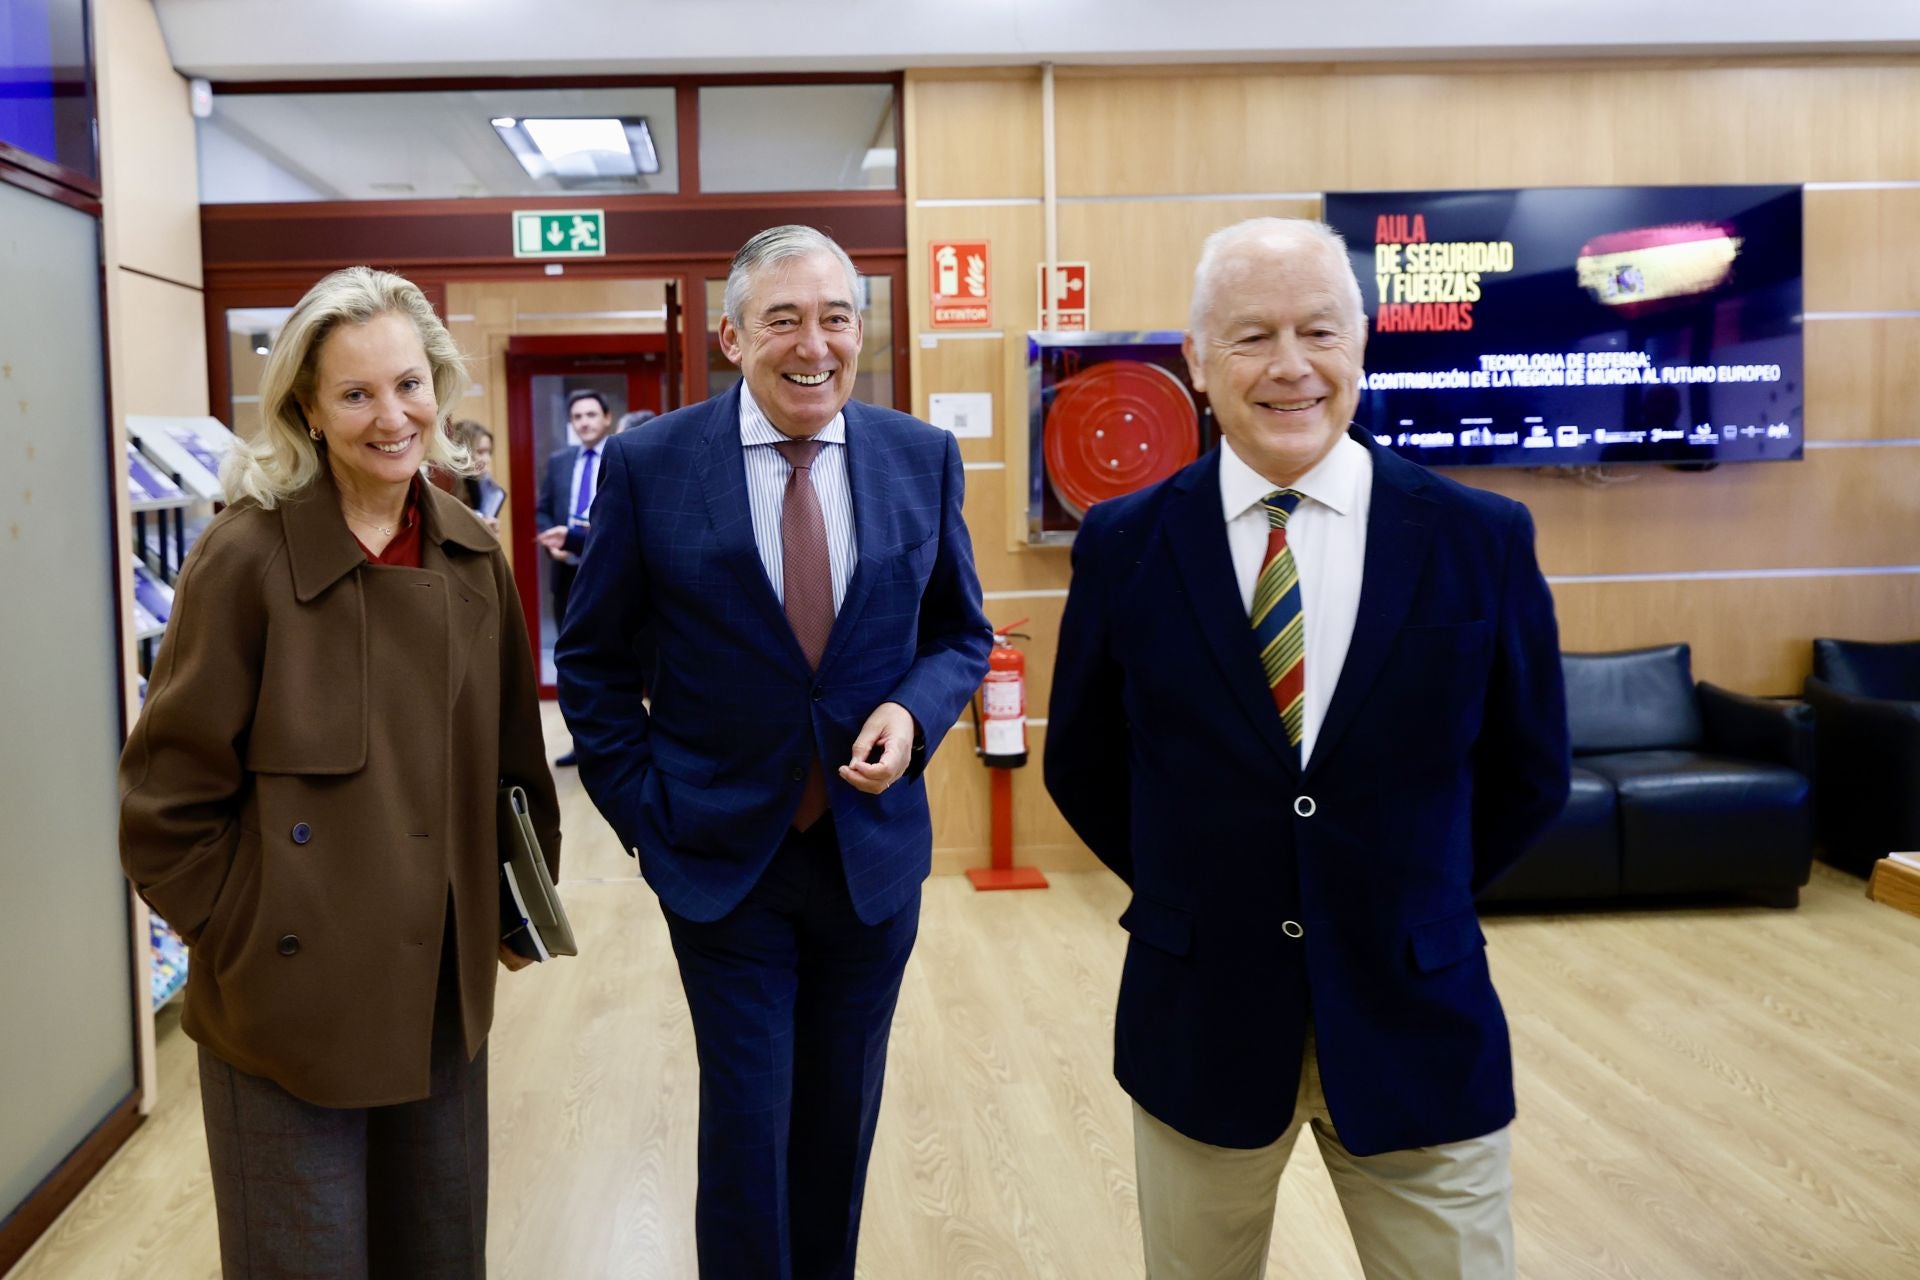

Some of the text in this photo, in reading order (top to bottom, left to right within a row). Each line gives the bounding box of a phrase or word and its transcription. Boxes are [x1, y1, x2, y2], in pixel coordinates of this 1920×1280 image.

[1375, 213, 1427, 243] AULA
[1375, 241, 1514, 274] DE SEGURIDAD
[1376, 271, 1482, 304] Y FUERZAS
[935, 308, 987, 321] EXTINTOR
[1376, 301, 1474, 332] ARMADAS
[1566, 353, 1585, 369] DE
[1586, 351, 1651, 369] DEFENSA:
[1368, 368, 1470, 390] CONTRIBUCIÓN
[1471, 371, 1491, 388] DE
[1492, 370, 1512, 388] LA
[1565, 368, 1585, 386] DE
[1586, 367, 1642, 385] MURCIA
[1642, 366, 1661, 384] AL
[1661, 365, 1716, 384] FUTURO
[1717, 364, 1781, 383] EUROPEO
